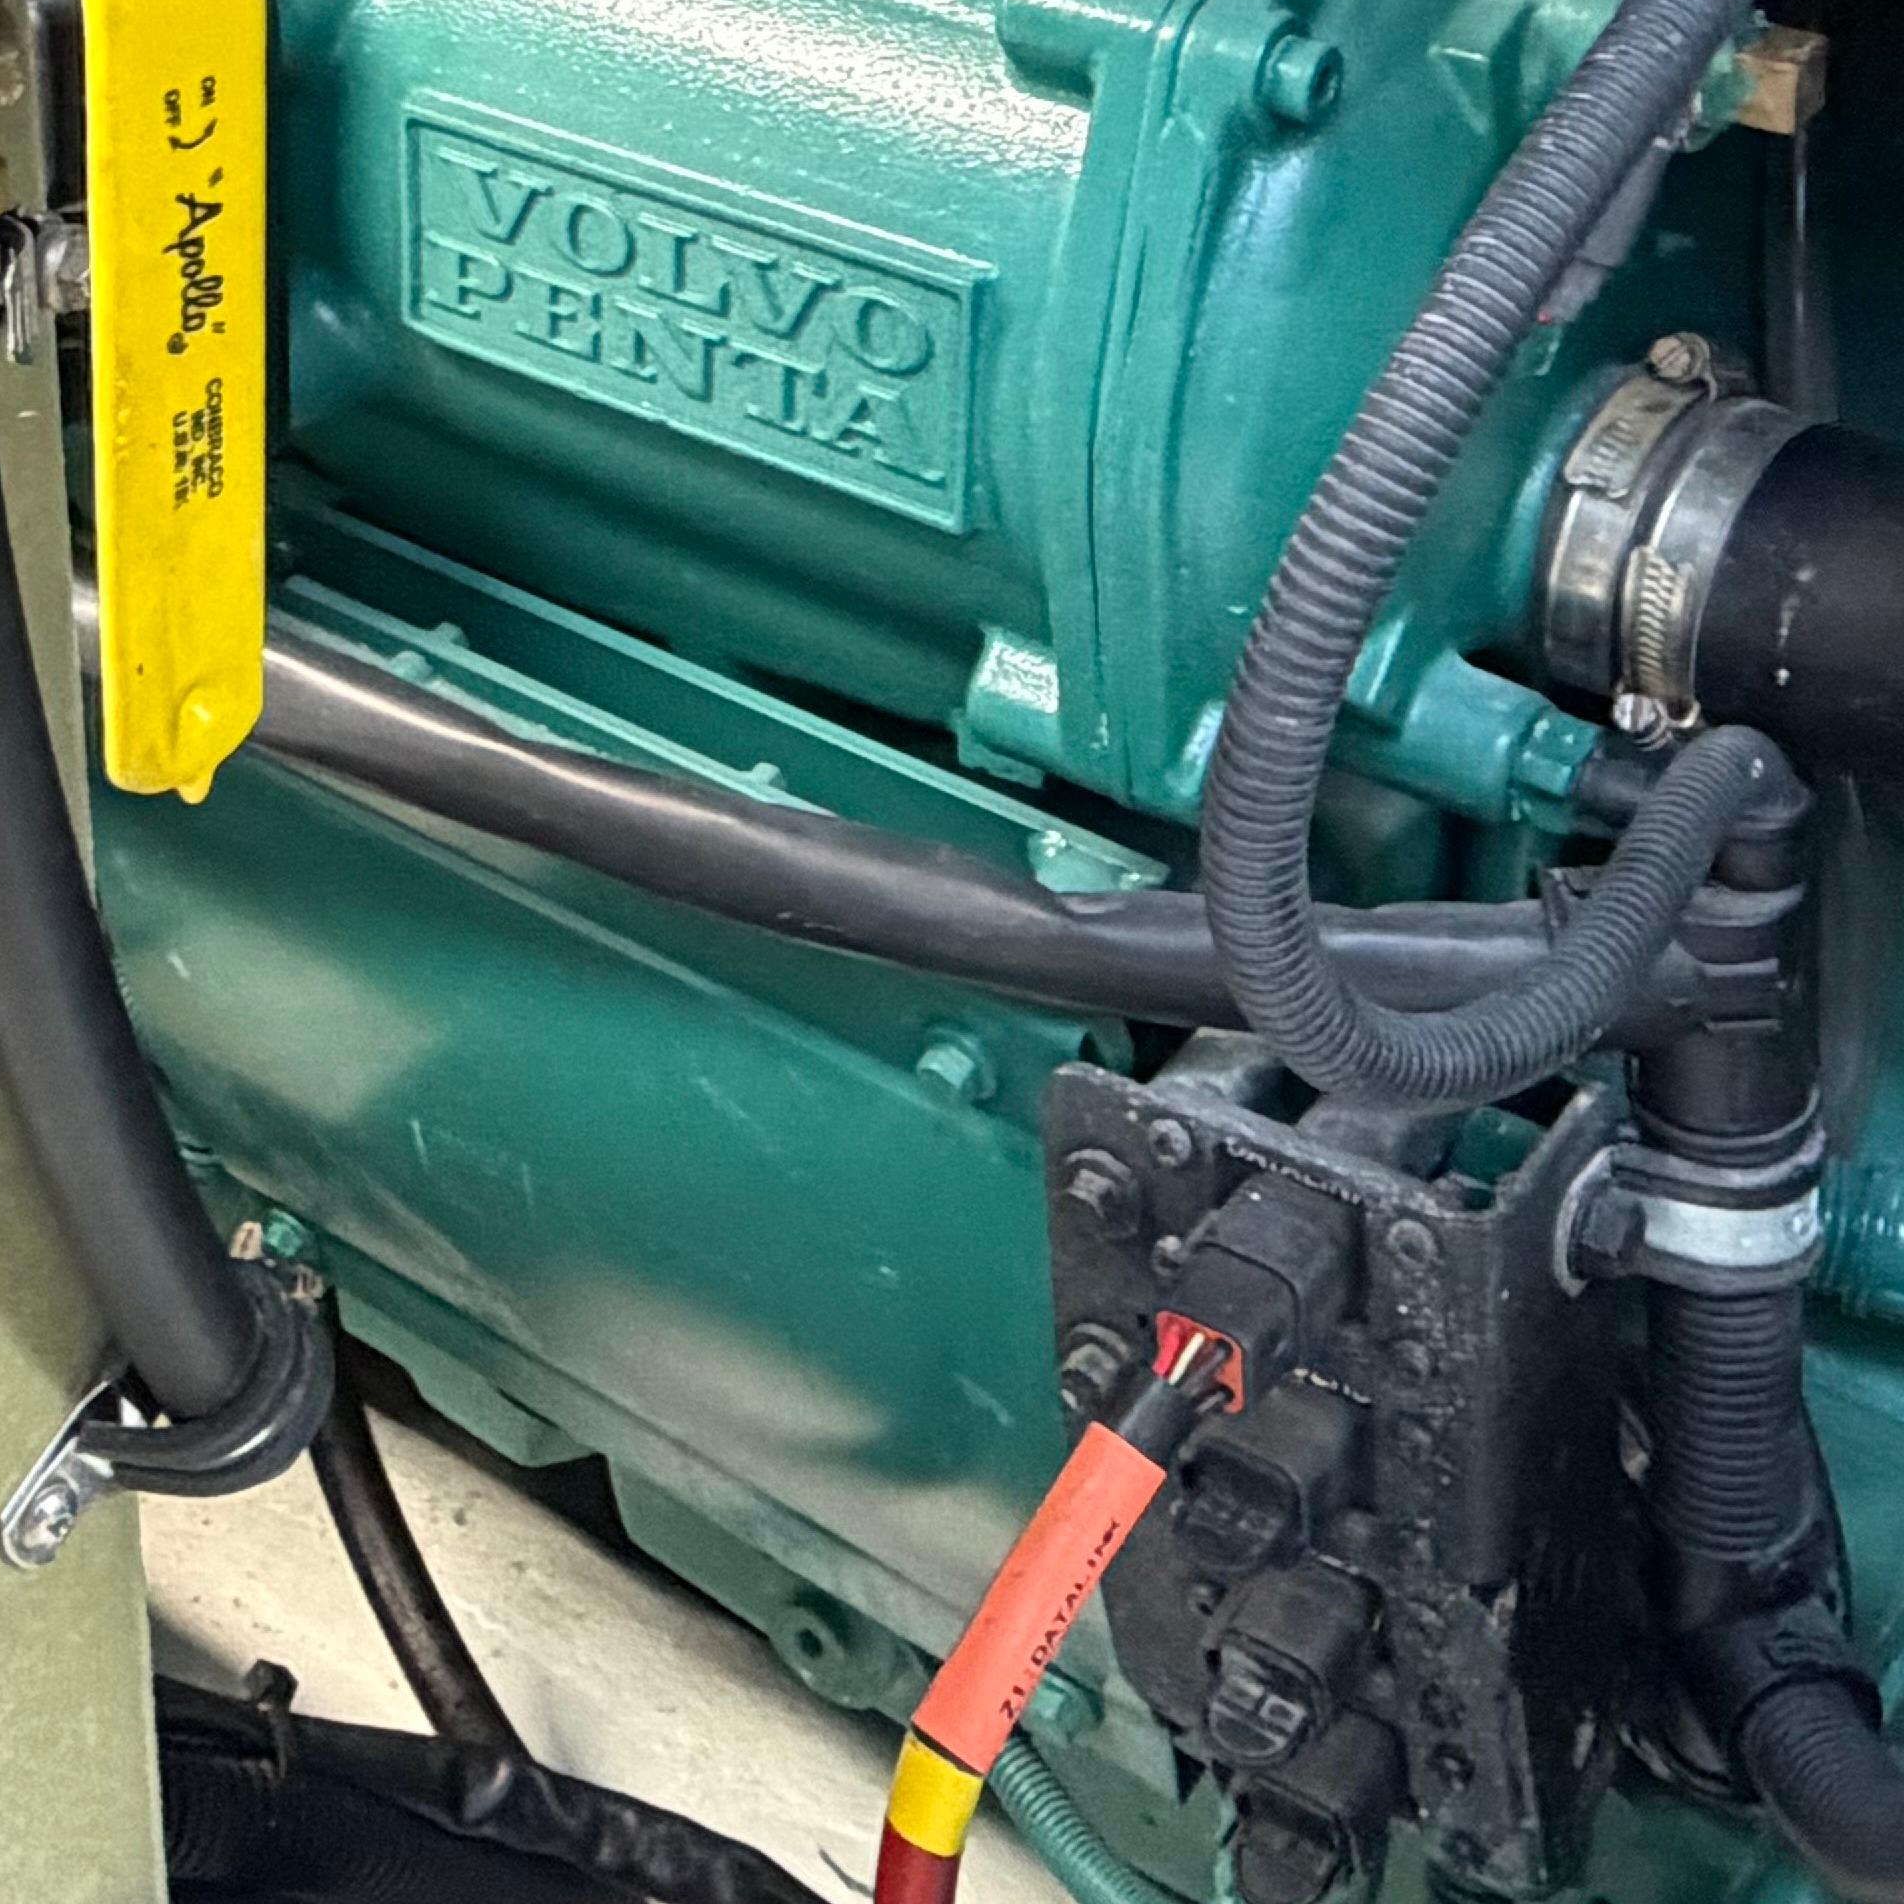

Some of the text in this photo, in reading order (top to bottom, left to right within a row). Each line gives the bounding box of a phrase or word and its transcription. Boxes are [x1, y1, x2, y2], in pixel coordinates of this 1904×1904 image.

[164, 88, 181, 129] OFF
[200, 75, 217, 107] ON
[434, 145, 936, 379] VOLVO
[424, 231, 948, 487] PENTA
[206, 377, 224, 499] CONBRACO
